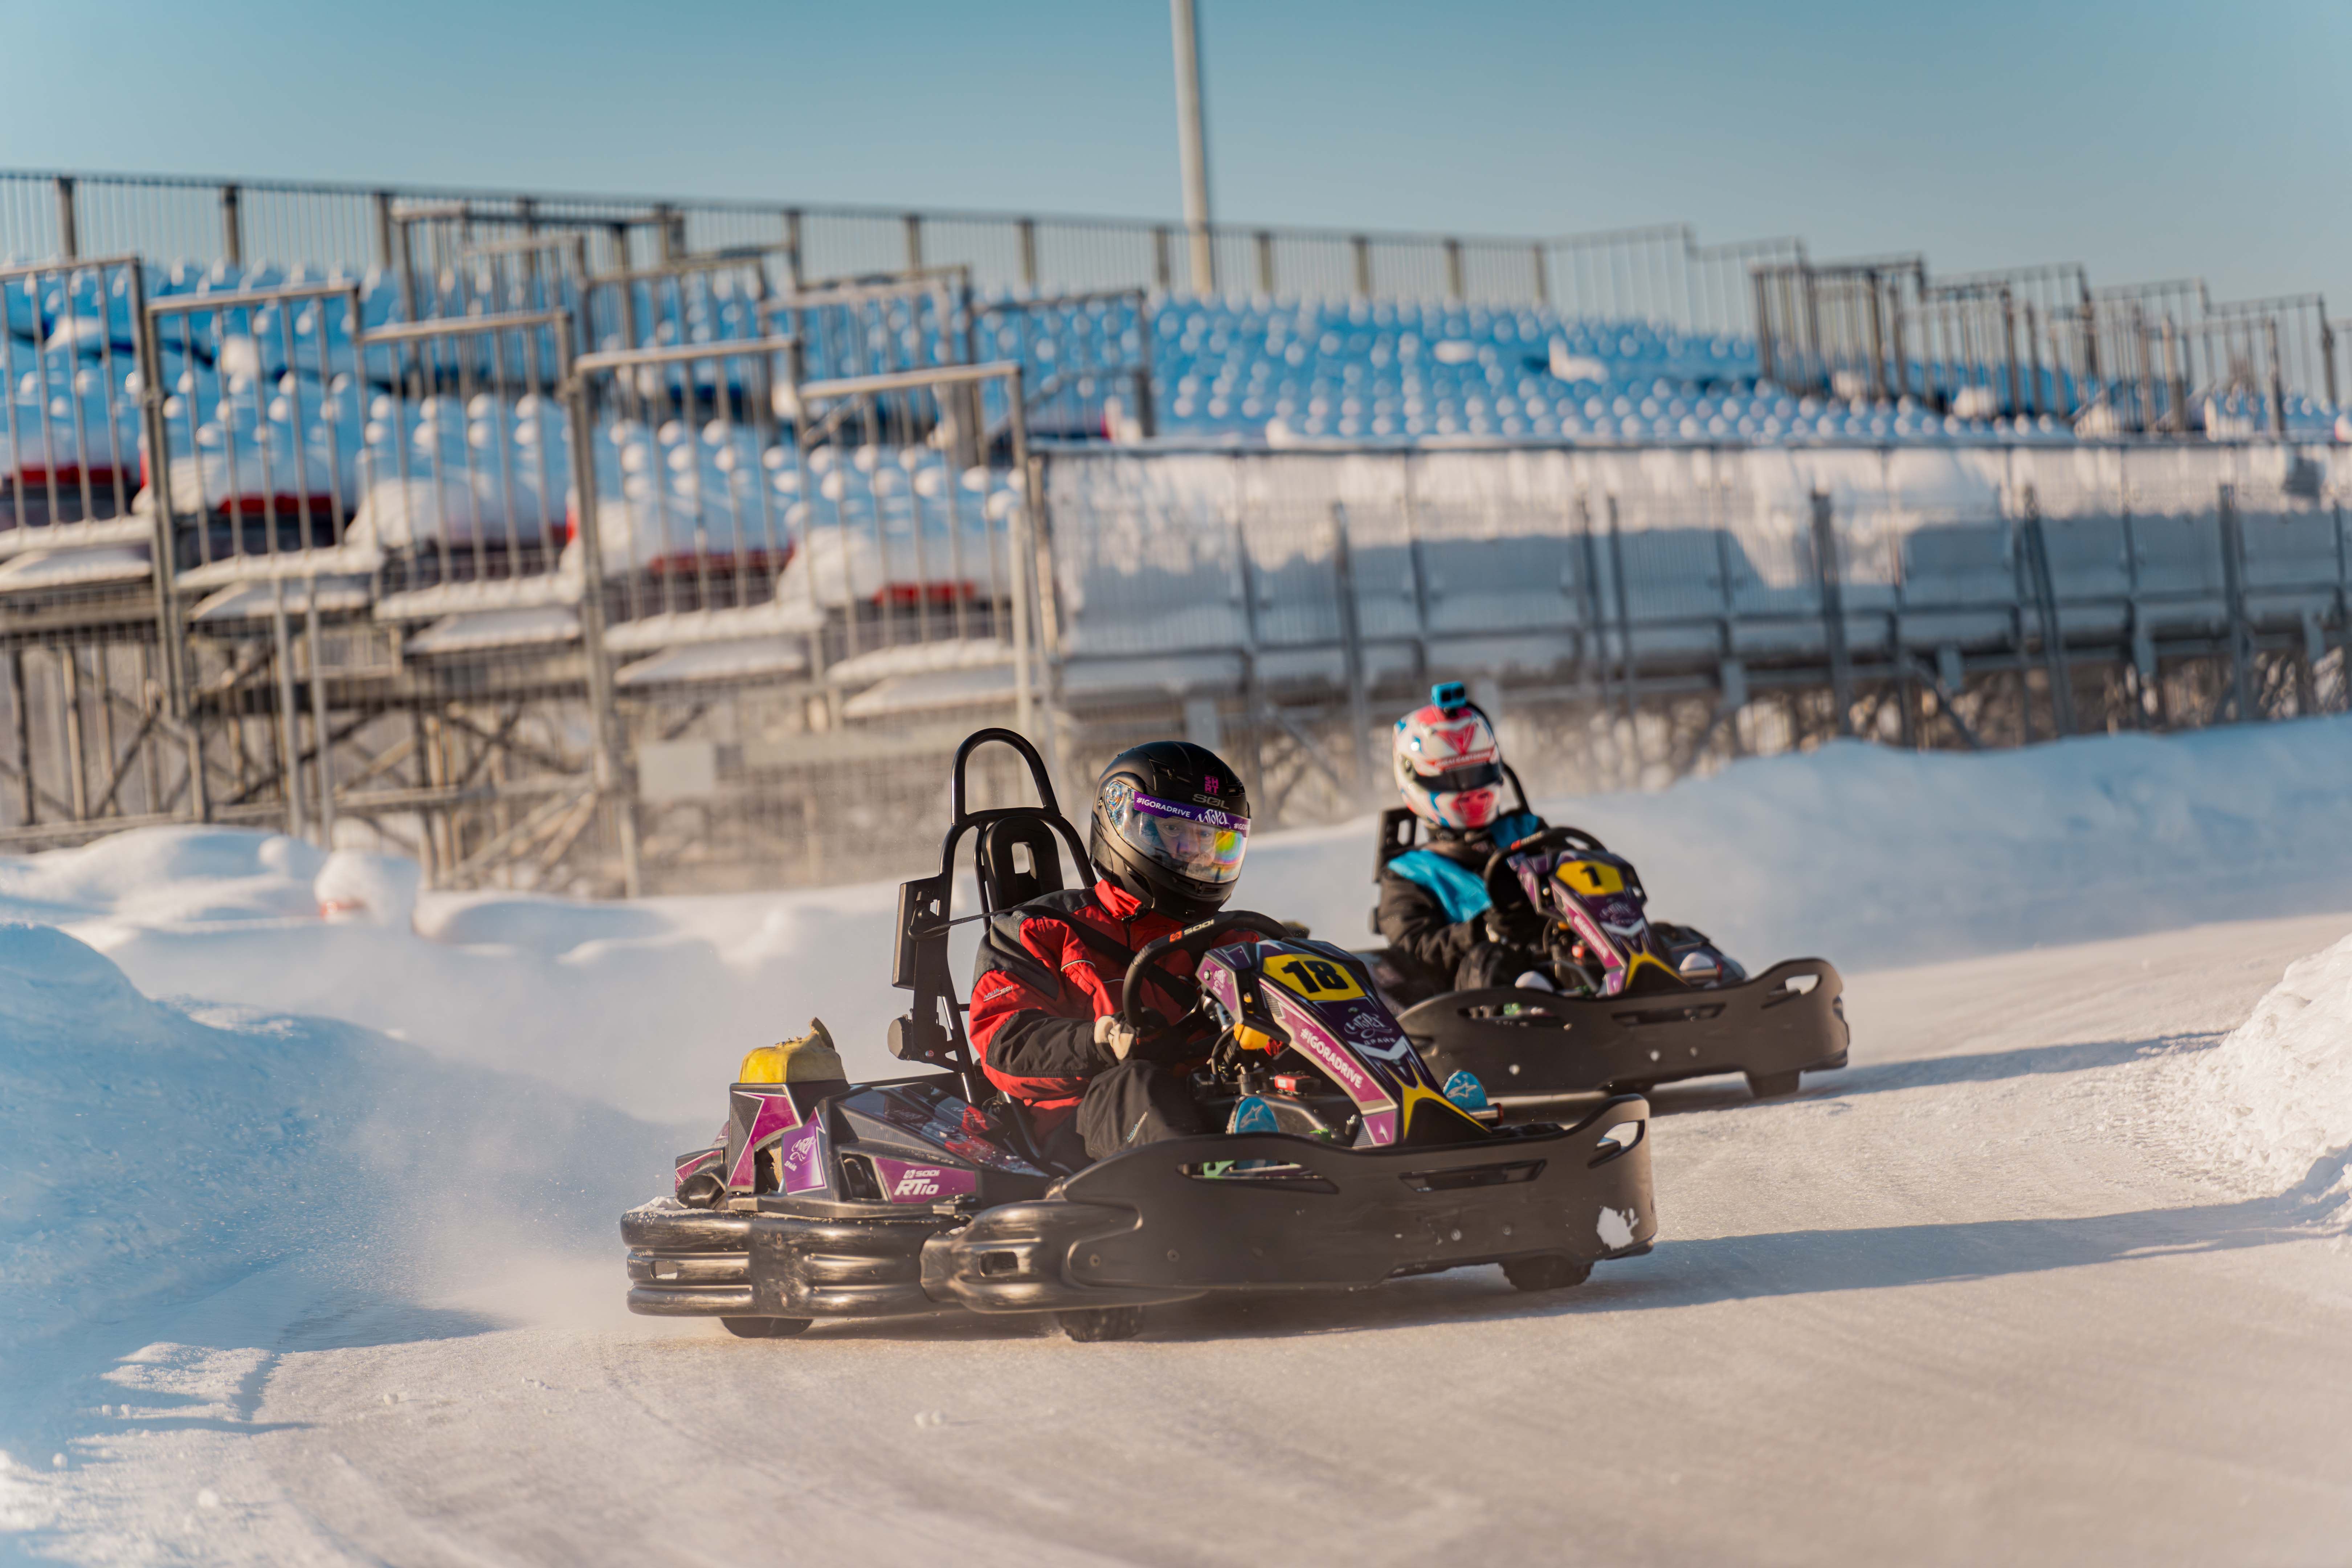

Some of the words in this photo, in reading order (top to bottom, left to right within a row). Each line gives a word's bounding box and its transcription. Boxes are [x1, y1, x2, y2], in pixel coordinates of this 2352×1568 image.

[1136, 797, 1191, 817] #IGORADRIVE
[1580, 866, 1601, 887] 1
[1281, 960, 1349, 993] 18
[1300, 1028, 1363, 1089] #IGORADRIVE
[894, 1179, 939, 1195] RT10
